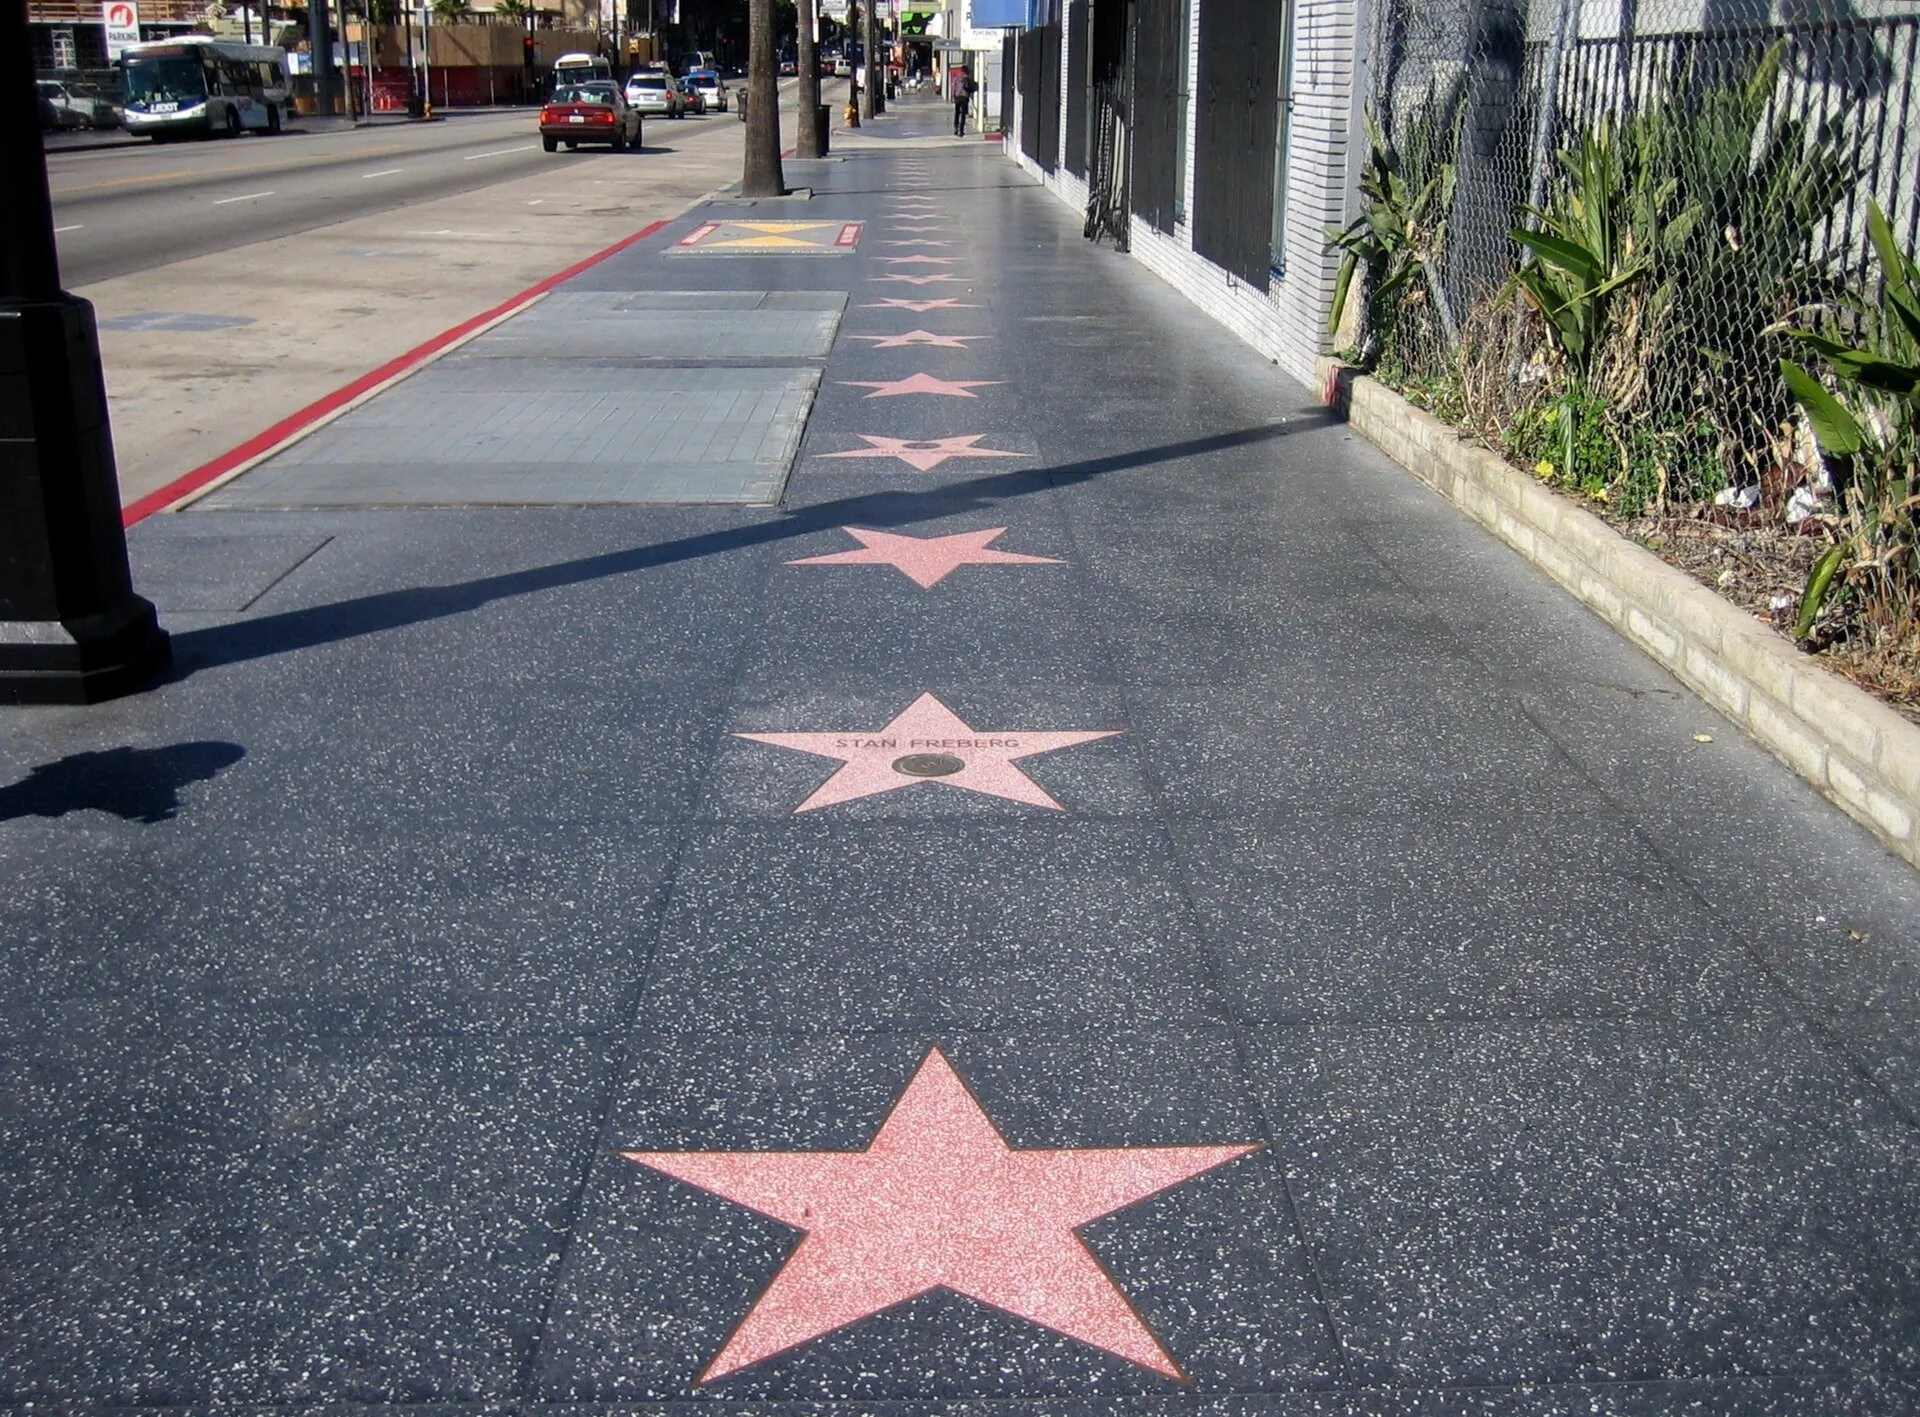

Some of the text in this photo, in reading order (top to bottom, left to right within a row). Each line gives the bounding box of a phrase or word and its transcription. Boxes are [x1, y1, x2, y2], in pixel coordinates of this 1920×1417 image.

[108, 32, 137, 41] PARKING
[836, 739, 1020, 748] STAN FREBERG
